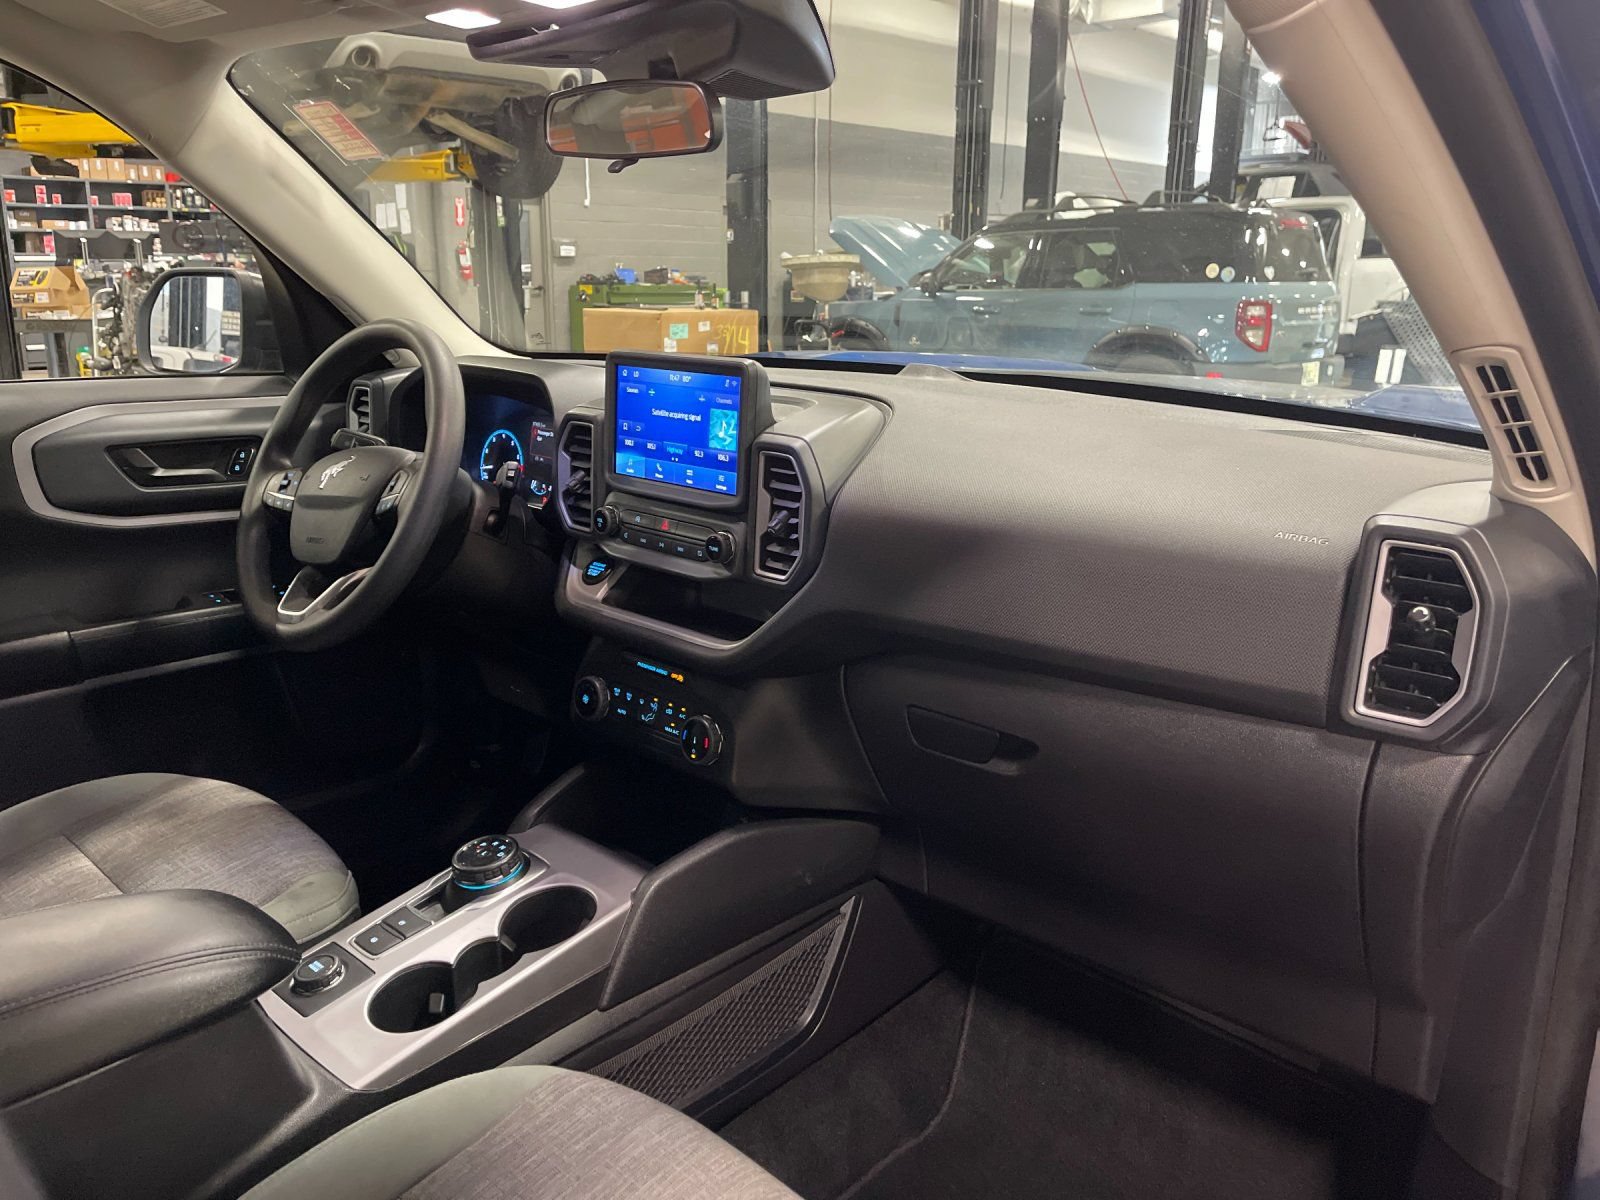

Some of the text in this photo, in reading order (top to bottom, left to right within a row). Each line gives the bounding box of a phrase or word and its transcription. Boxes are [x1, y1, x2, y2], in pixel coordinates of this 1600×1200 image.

[652, 408, 702, 422] Satellite acquiring signal
[1273, 531, 1329, 545] AIRBAG
